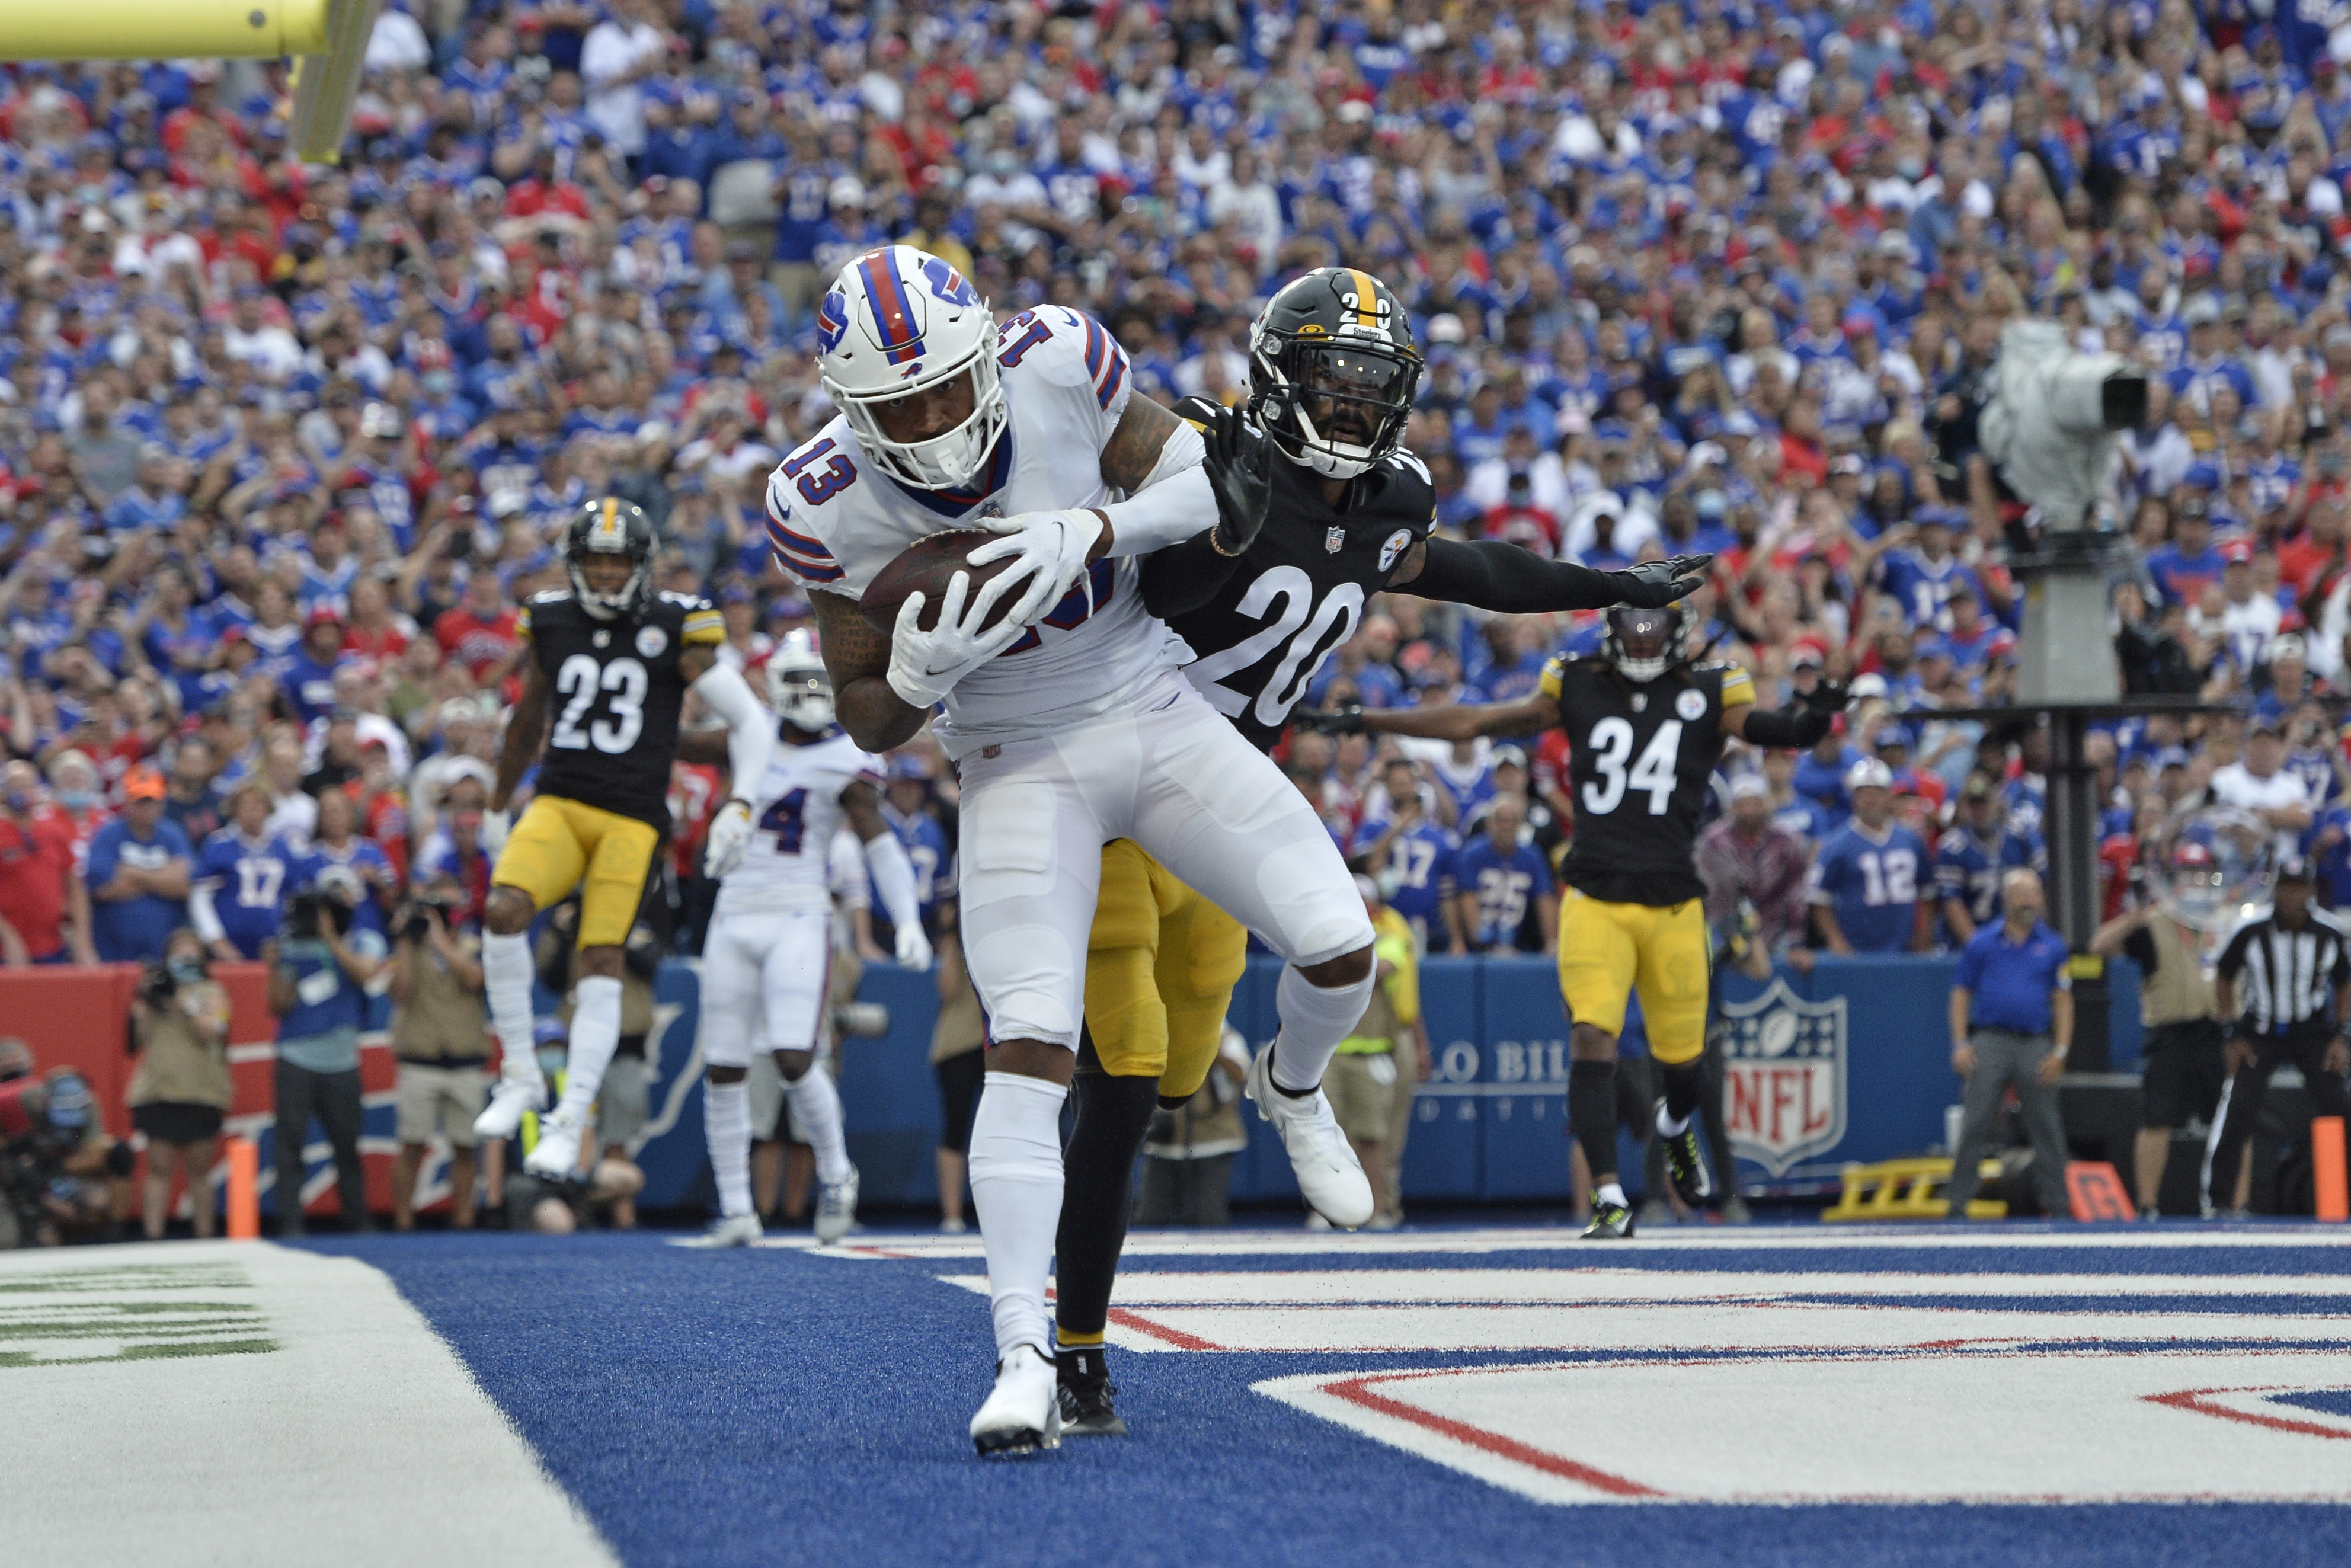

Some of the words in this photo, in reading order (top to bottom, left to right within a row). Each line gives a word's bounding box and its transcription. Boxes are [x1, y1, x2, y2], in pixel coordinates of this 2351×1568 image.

[1340, 292, 1392, 329] 20
[1353, 327, 1382, 340] Steelers
[781, 437, 858, 506] 13
[1329, 538, 1340, 549] NFL
[1180, 565, 1365, 727] 20
[551, 654, 648, 754] 23
[1582, 716, 1683, 815] 34
[760, 787, 808, 852] 4
[235, 857, 286, 908] 17
[1857, 848, 1918, 907] 12
[1725, 1068, 1828, 1145] NFL
